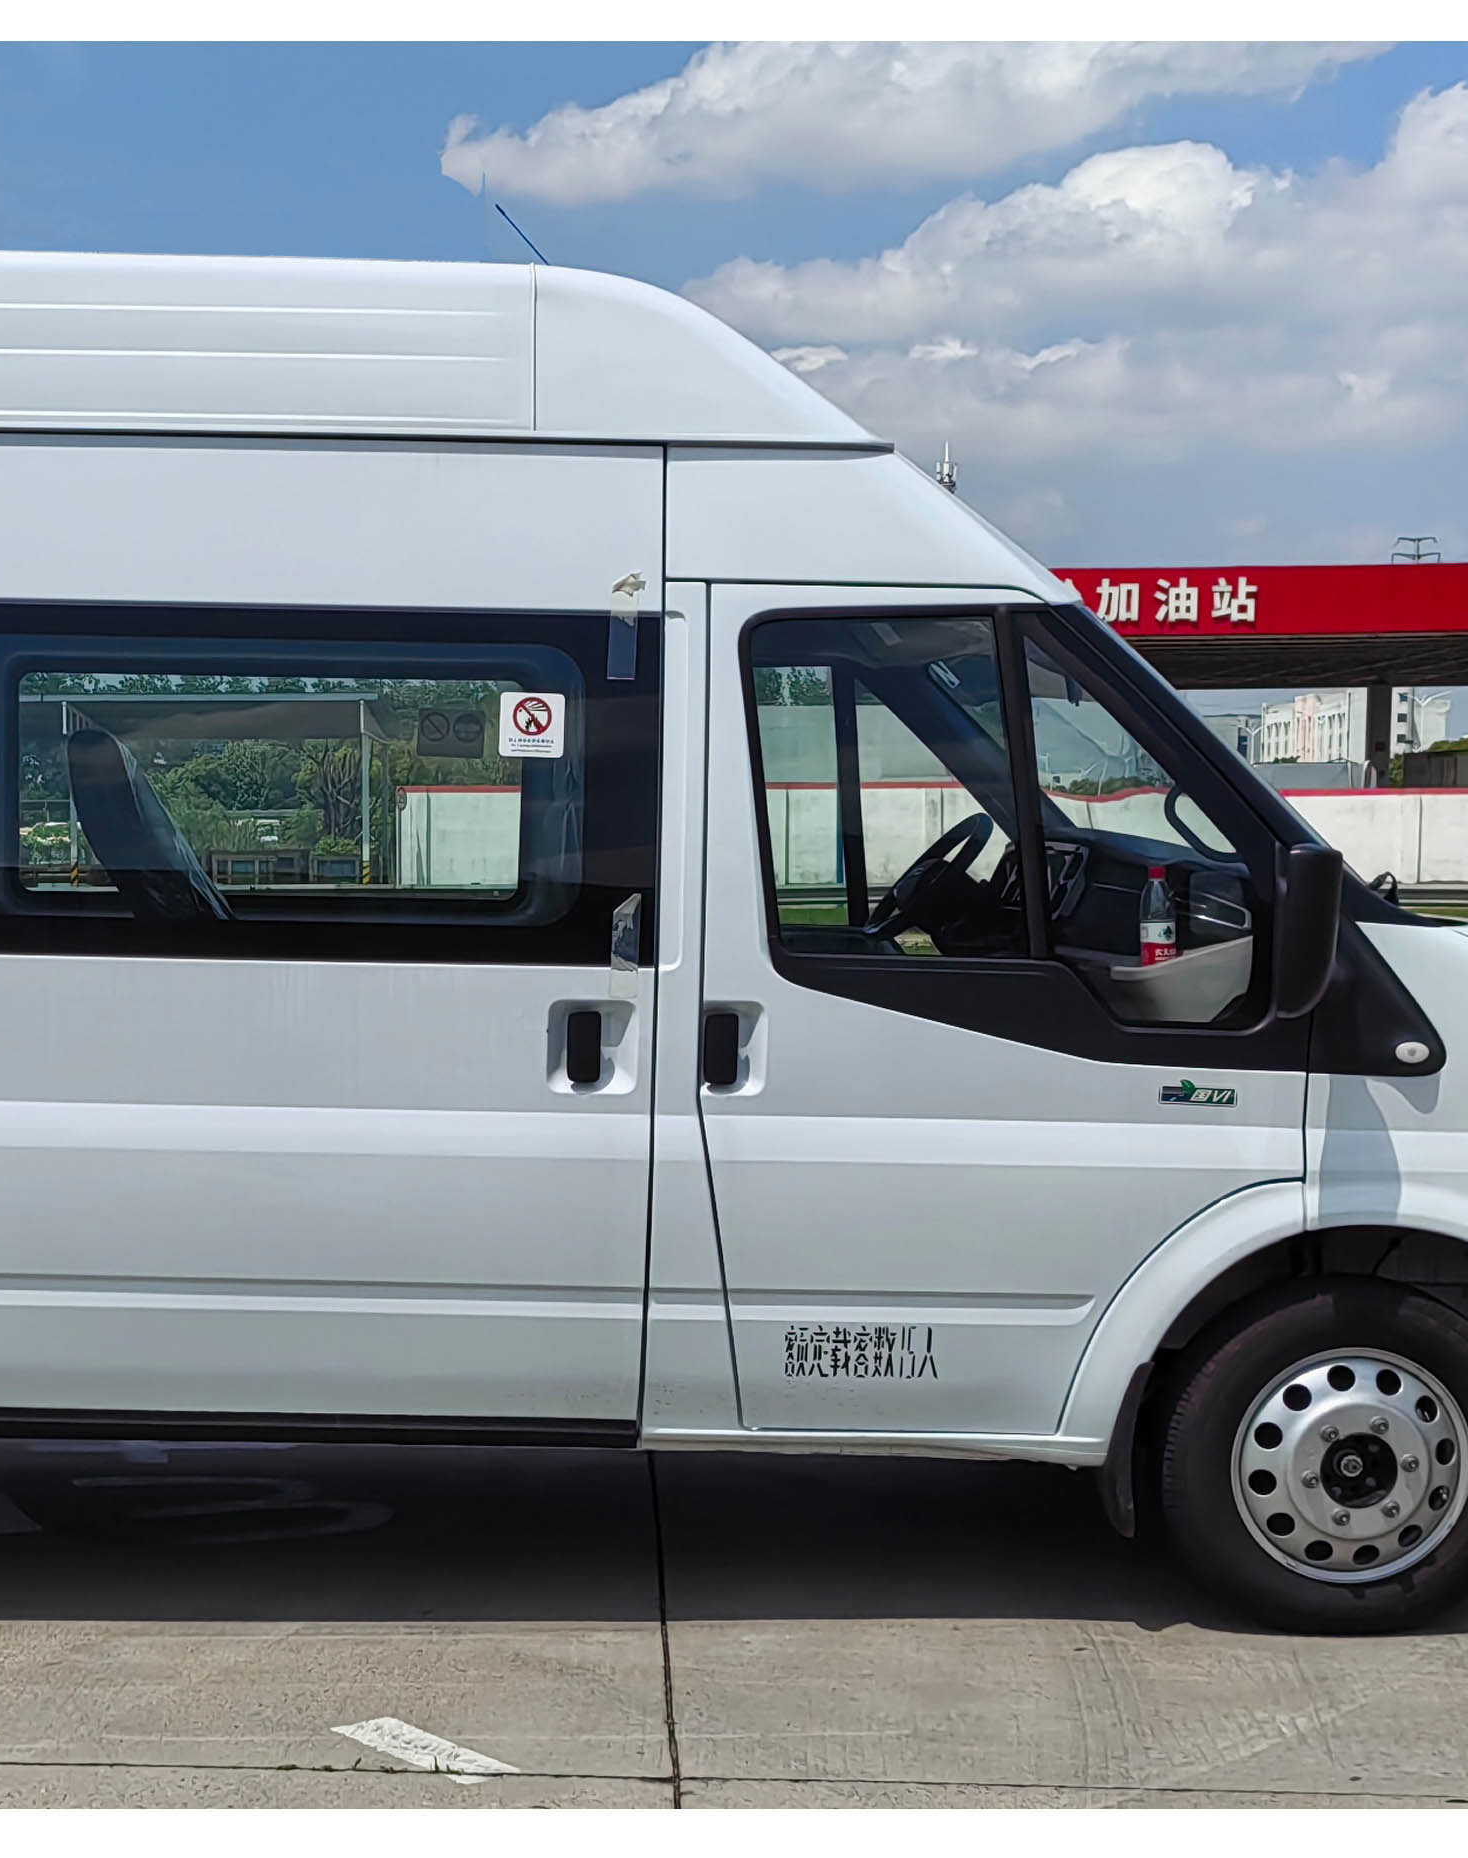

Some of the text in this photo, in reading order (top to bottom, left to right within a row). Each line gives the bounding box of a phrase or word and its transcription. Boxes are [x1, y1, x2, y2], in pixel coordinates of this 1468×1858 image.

[1064, 577, 1258, 622] 加油站
[784, 1325, 939, 1379] 额定载客数15人
